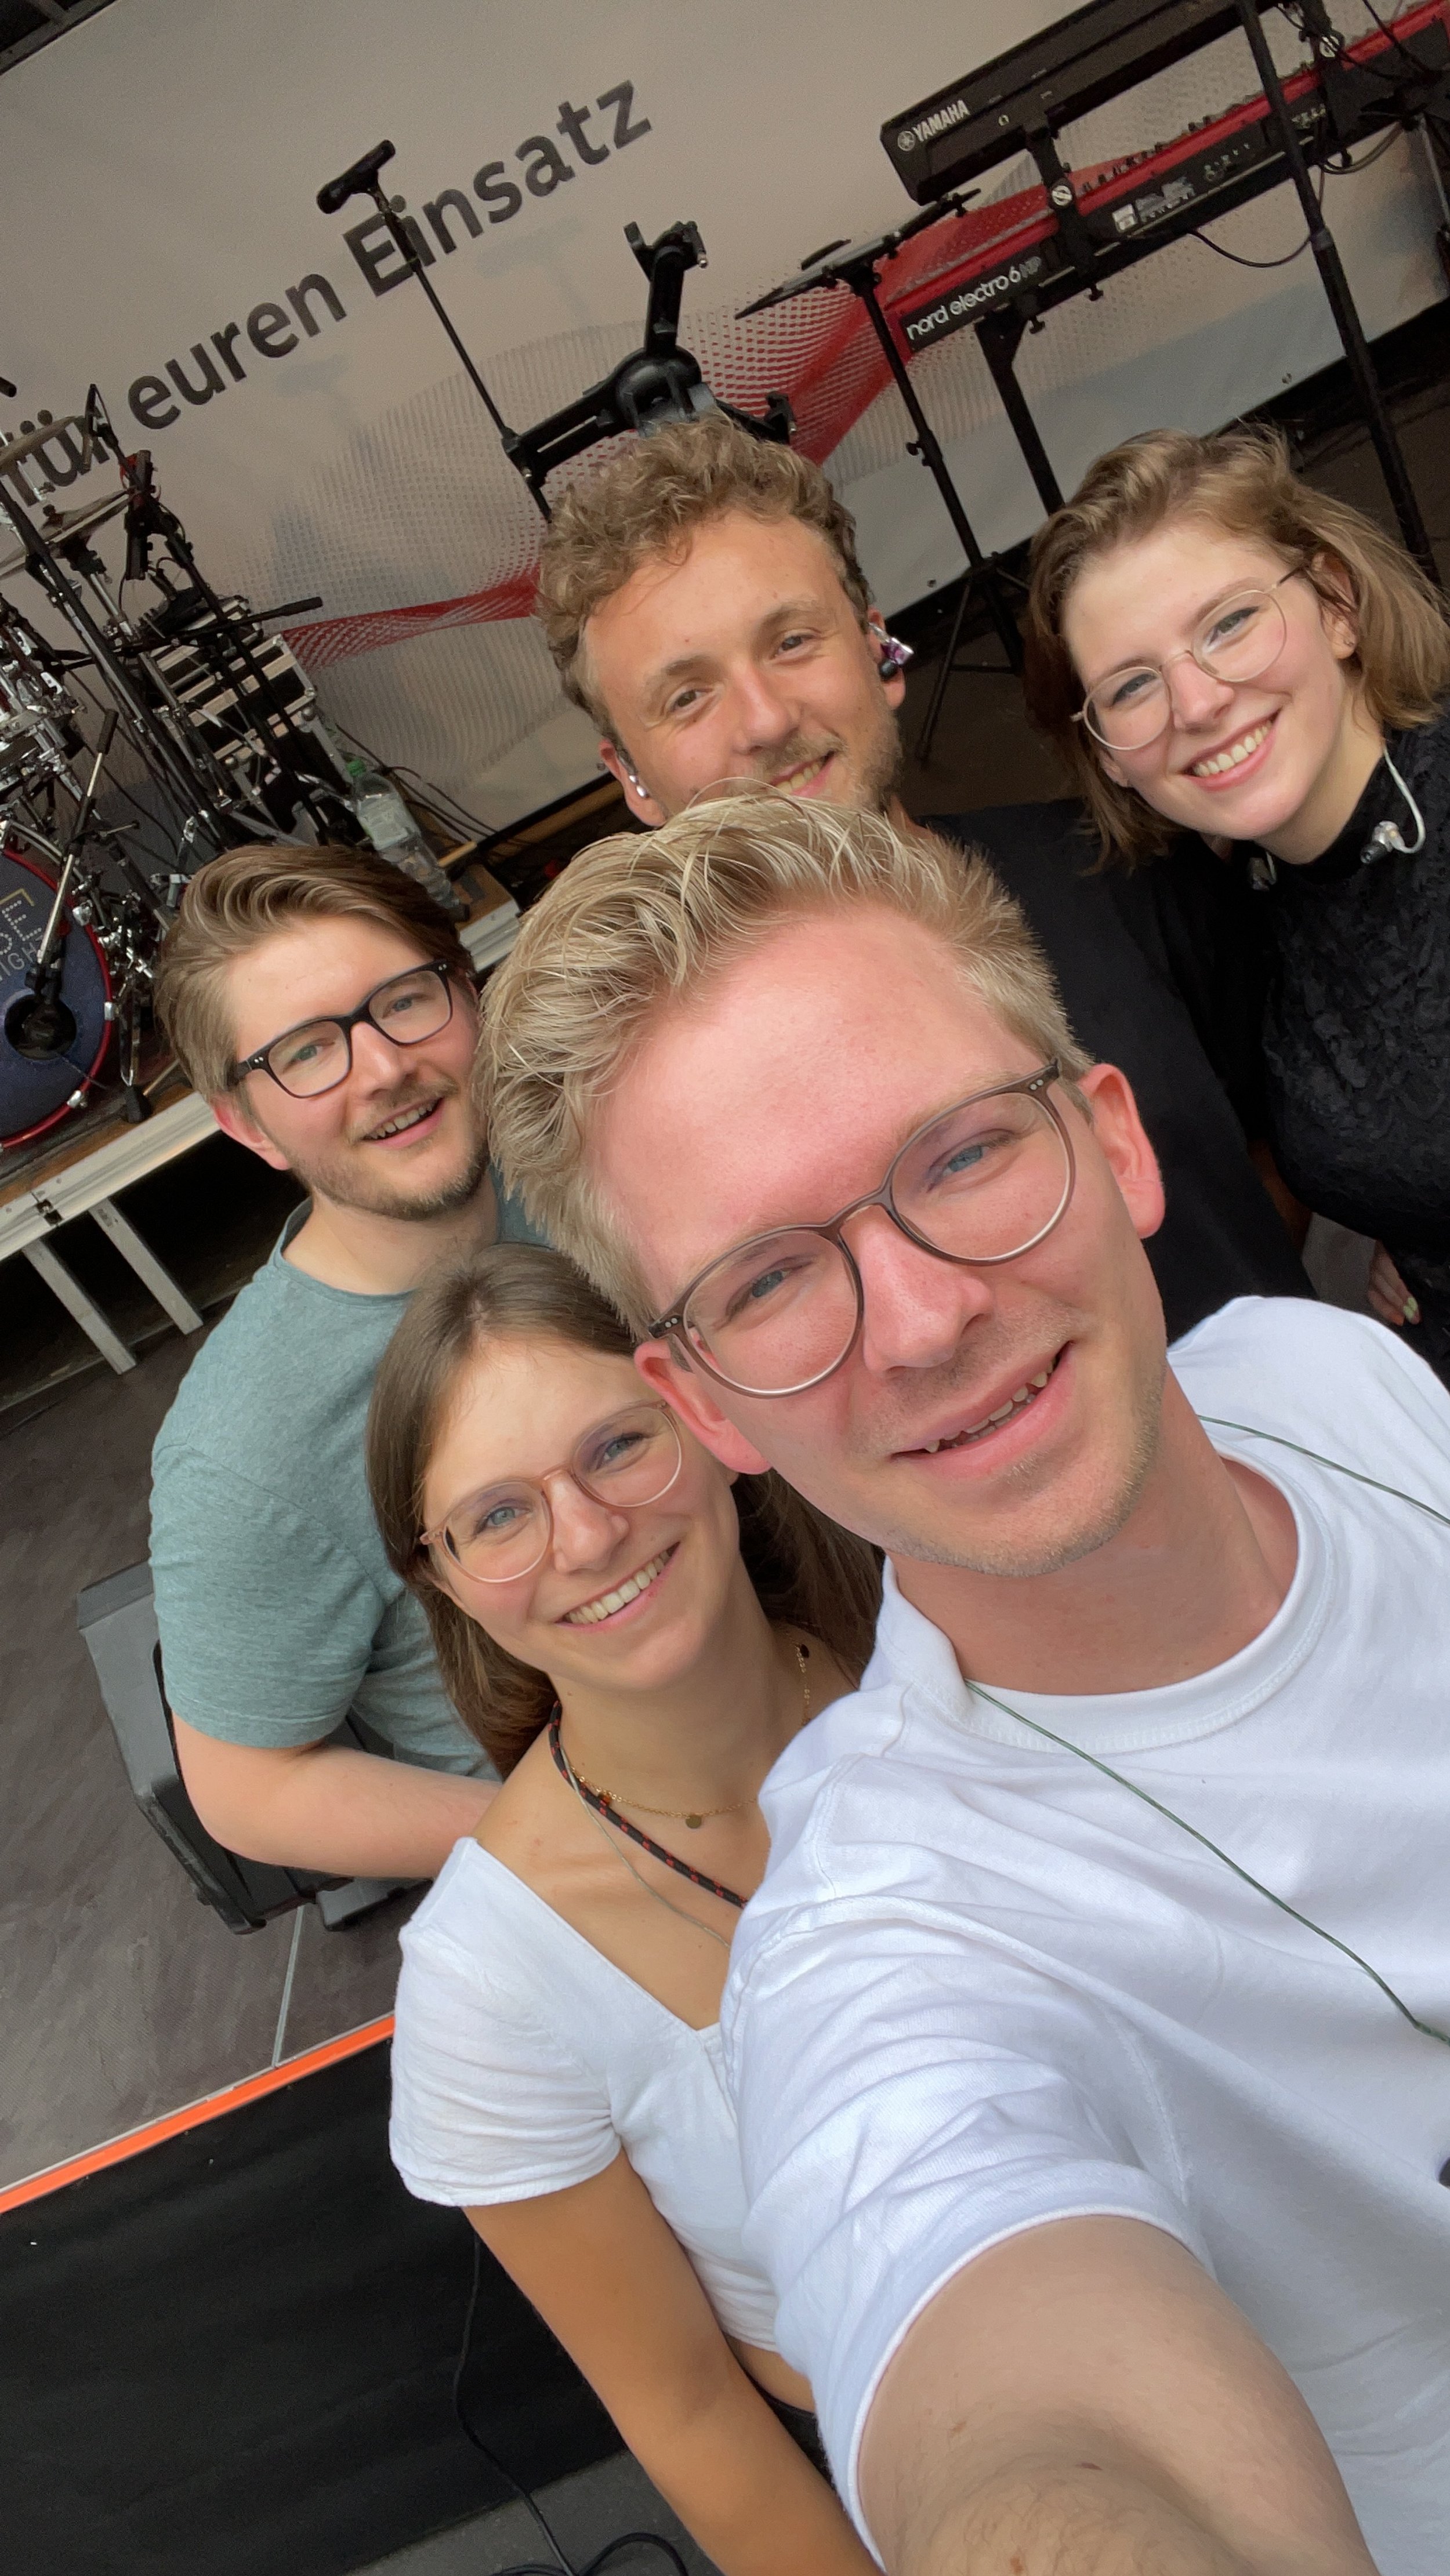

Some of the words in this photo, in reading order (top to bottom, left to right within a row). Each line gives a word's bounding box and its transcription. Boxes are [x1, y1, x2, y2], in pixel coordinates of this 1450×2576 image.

[911, 99, 970, 142] YAMAHA
[127, 273, 346, 430] euren
[342, 79, 652, 297] Einsatz
[907, 305, 949, 340] nord
[949, 275, 1009, 315] electro
